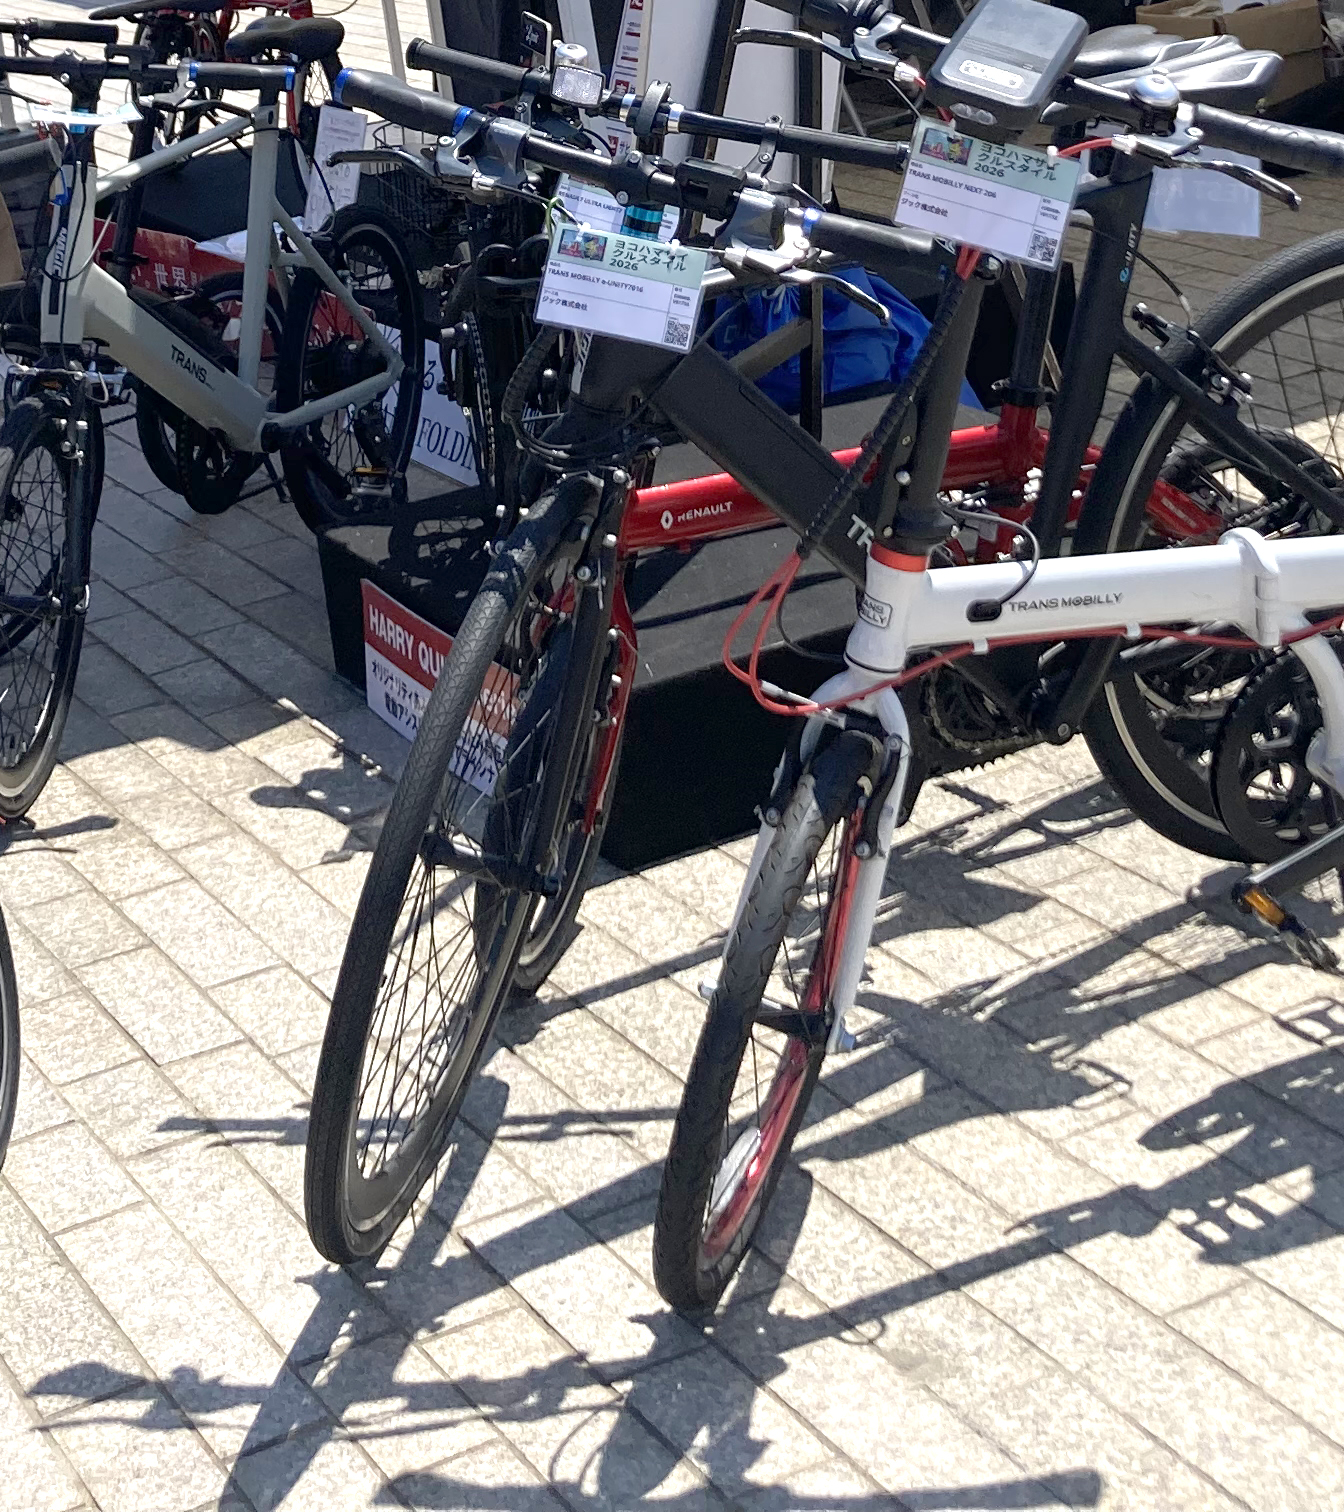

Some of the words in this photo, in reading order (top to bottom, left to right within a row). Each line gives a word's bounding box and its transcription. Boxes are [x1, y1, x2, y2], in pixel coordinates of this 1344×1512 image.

[977, 153, 1057, 181] クルスタイル
[979, 142, 1060, 171] ヨコハマサ
[908, 168, 931, 181] TRANS
[973, 163, 1005, 178] 2026
[609, 258, 639, 271] 2026
[612, 248, 687, 273] クルスタイル
[547, 268, 570, 279] TRANS
[541, 296, 588, 312] ジック株式会社
[170, 345, 207, 382] TRANS
[677, 501, 733, 523] RENAULT
[1009, 597, 1059, 612] TRANS
[1061, 592, 1123, 607] MOBILLY
[368, 603, 414, 661] HARRY
